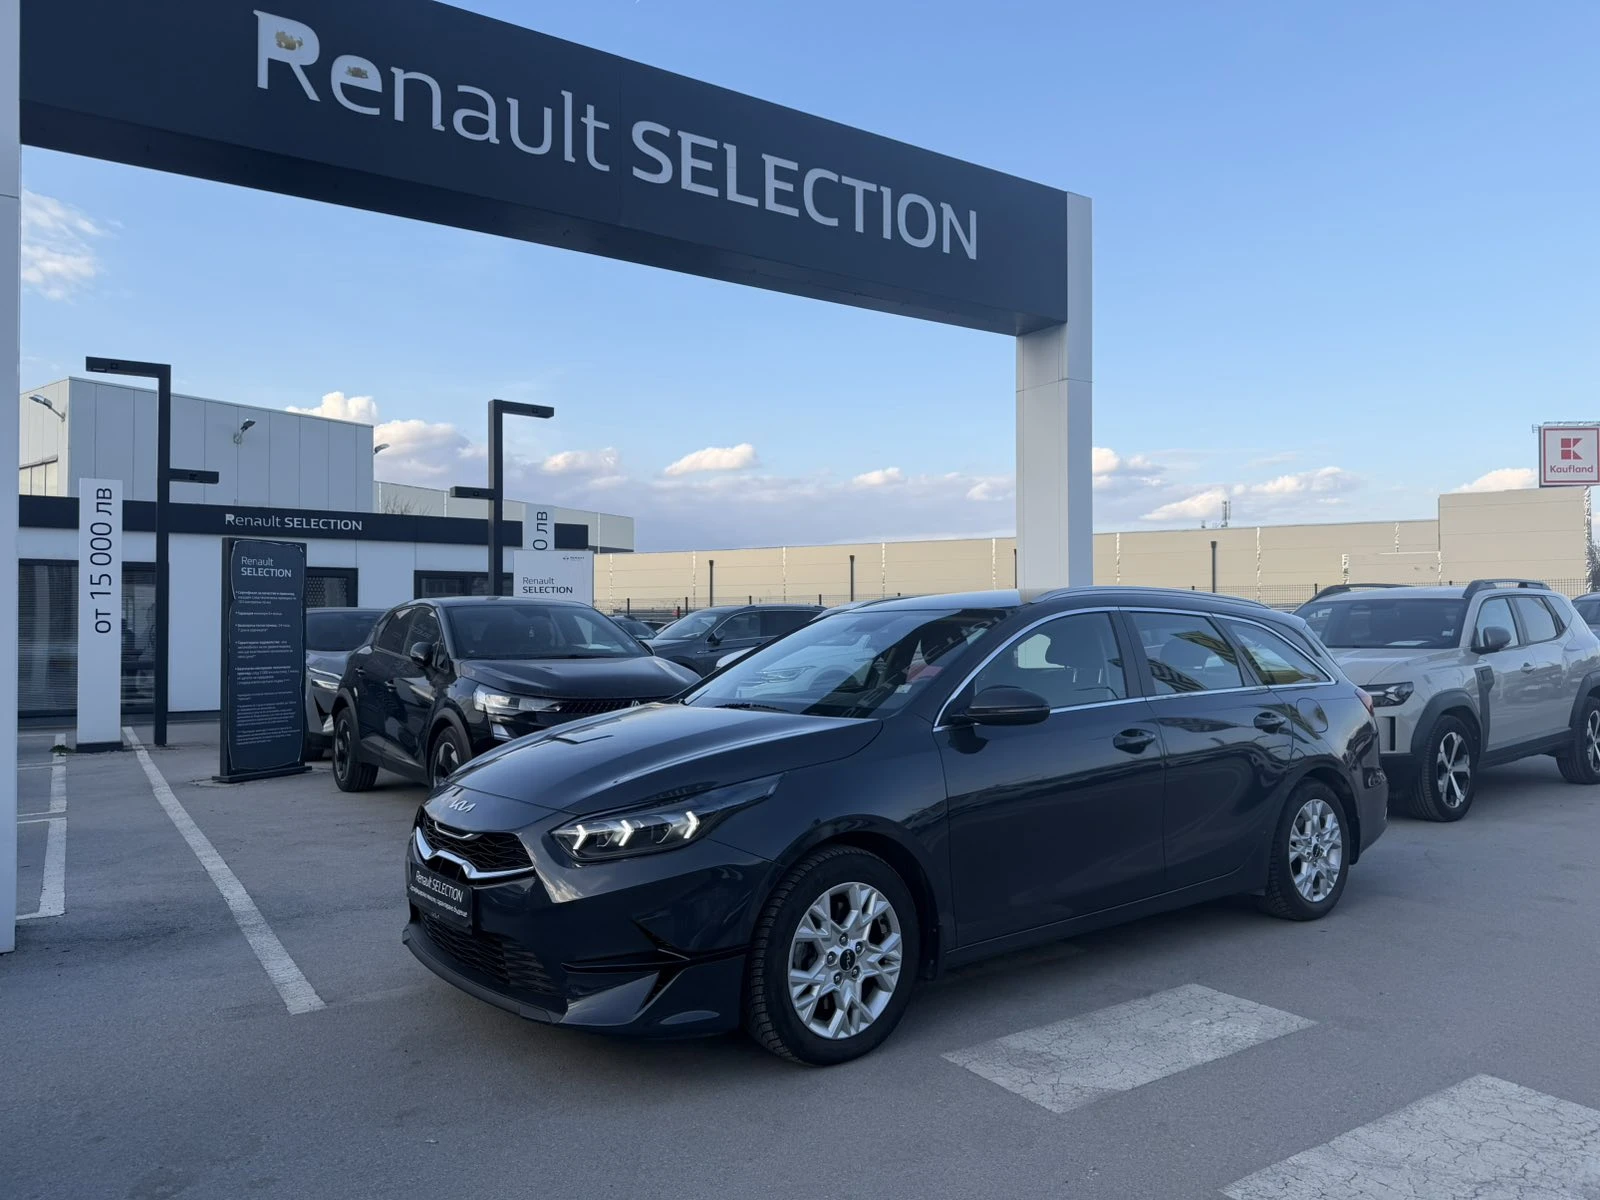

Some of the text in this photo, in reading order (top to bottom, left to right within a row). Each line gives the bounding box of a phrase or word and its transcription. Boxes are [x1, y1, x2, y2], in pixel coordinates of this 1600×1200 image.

[253, 9, 977, 260] Renault SELECTION
[1550, 465, 1594, 473] Kaufland
[225, 513, 363, 531] Renault SELECTION
[90, 522, 112, 566] 000
[241, 556, 274, 567] Renault
[241, 567, 292, 577] SELECTION
[522, 577, 555, 585] Renault
[90, 573, 112, 600] 15
[522, 586, 573, 594] SELECTION
[95, 608, 112, 634] от
[431, 878, 464, 903] SELECTION
